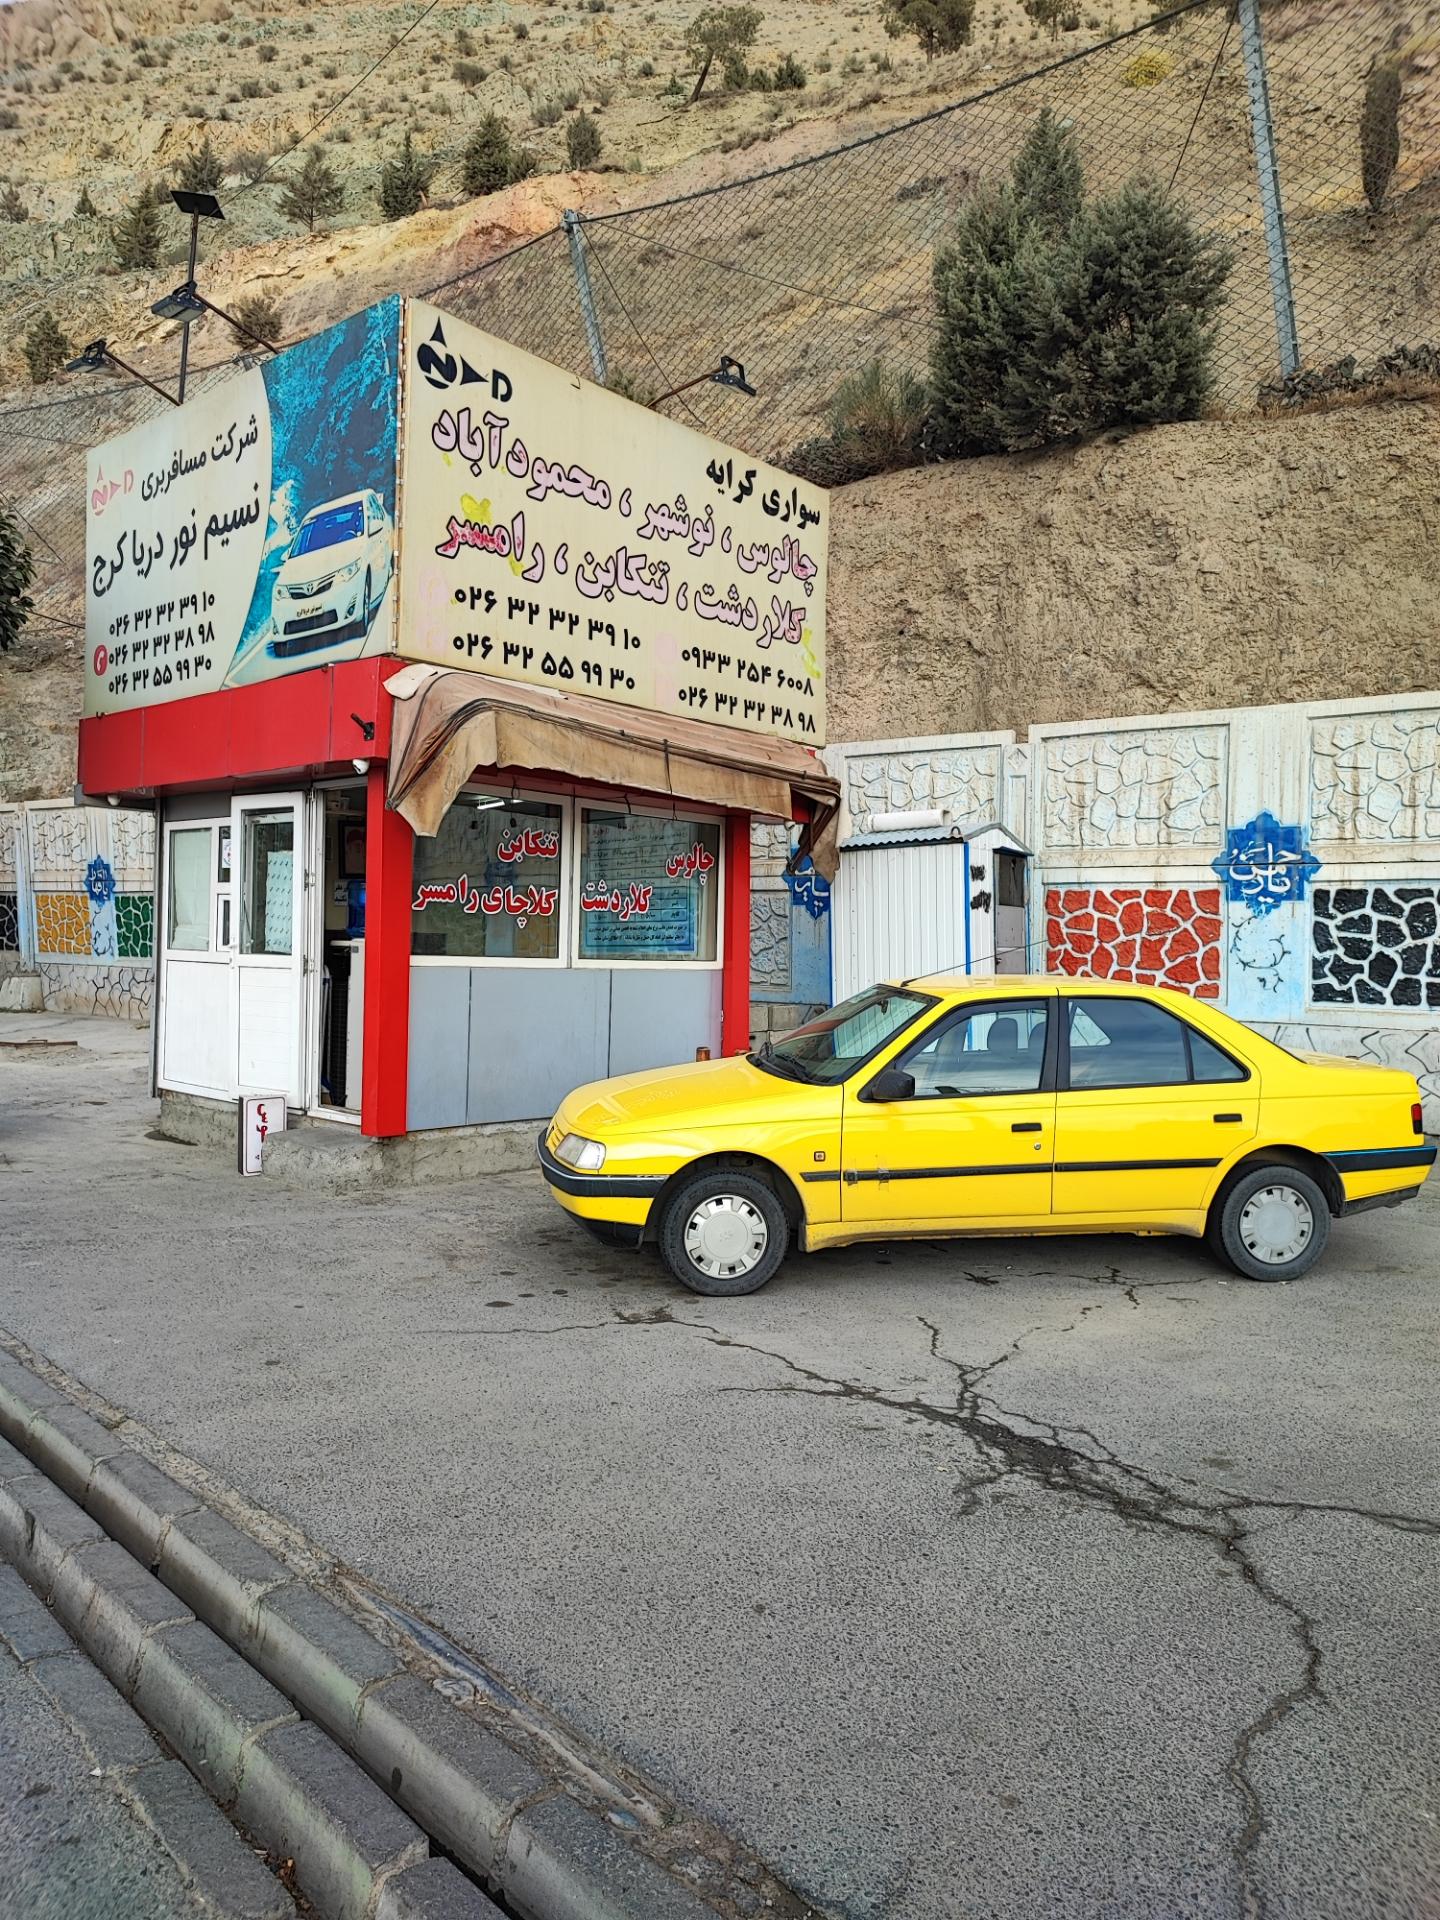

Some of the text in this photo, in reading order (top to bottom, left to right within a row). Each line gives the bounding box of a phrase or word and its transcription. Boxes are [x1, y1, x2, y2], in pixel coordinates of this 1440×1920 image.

[141, 414, 258, 501] شرکت مسافربری
[636, 493, 715, 557] نوشهر
[705, 458, 820, 529] سواری کرایه
[92, 482, 260, 597] نسیم نور دریا کرج
[435, 511, 545, 583] رامسر
[736, 534, 818, 597] چالوس
[575, 546, 670, 604] تنکابن
[694, 583, 806, 649] کلاردشت
[498, 827, 558, 862] تنکابن
[666, 842, 714, 885] چالوس
[412, 873, 558, 929] کلاچای رامسر
[581, 880, 652, 921] کلاردشت
